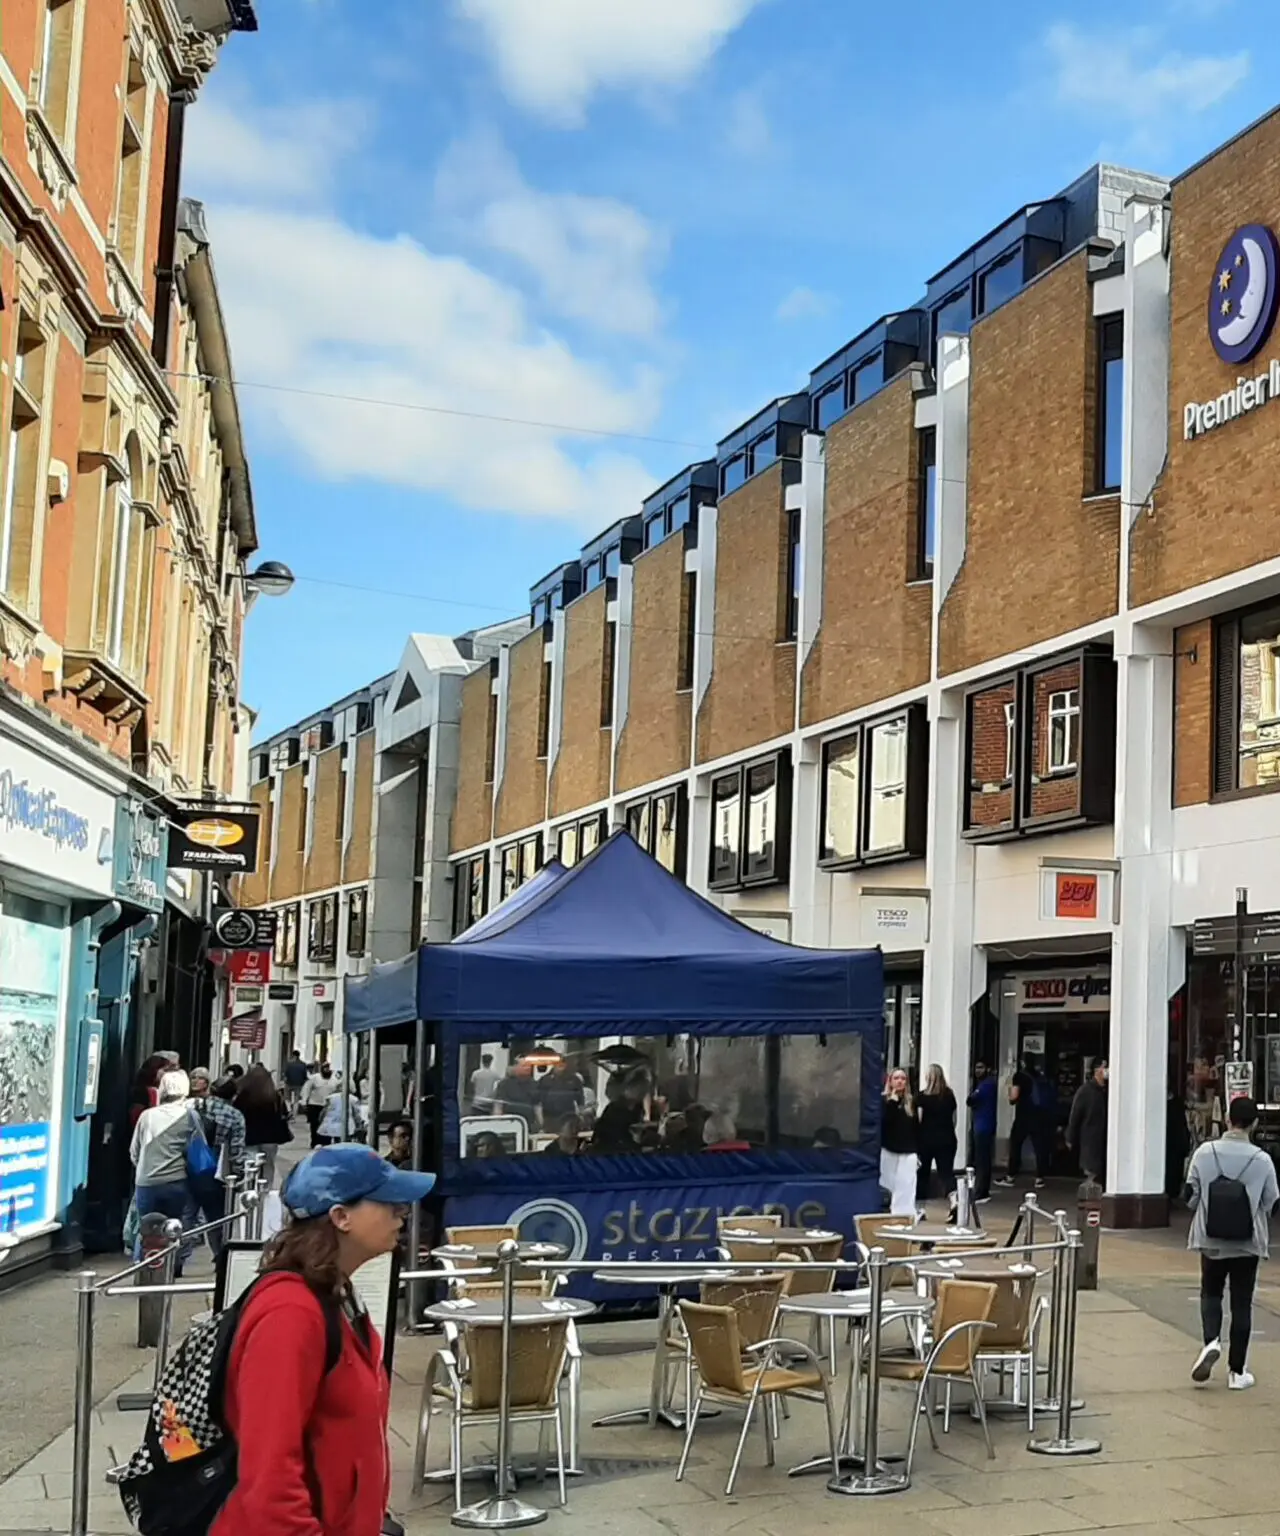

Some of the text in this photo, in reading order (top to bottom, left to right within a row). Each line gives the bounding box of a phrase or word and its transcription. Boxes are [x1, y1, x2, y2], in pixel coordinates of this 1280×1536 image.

[1184, 375, 1270, 440] Premier
[877, 908, 909, 917] TESCO
[1022, 978, 1067, 999] TESCO
